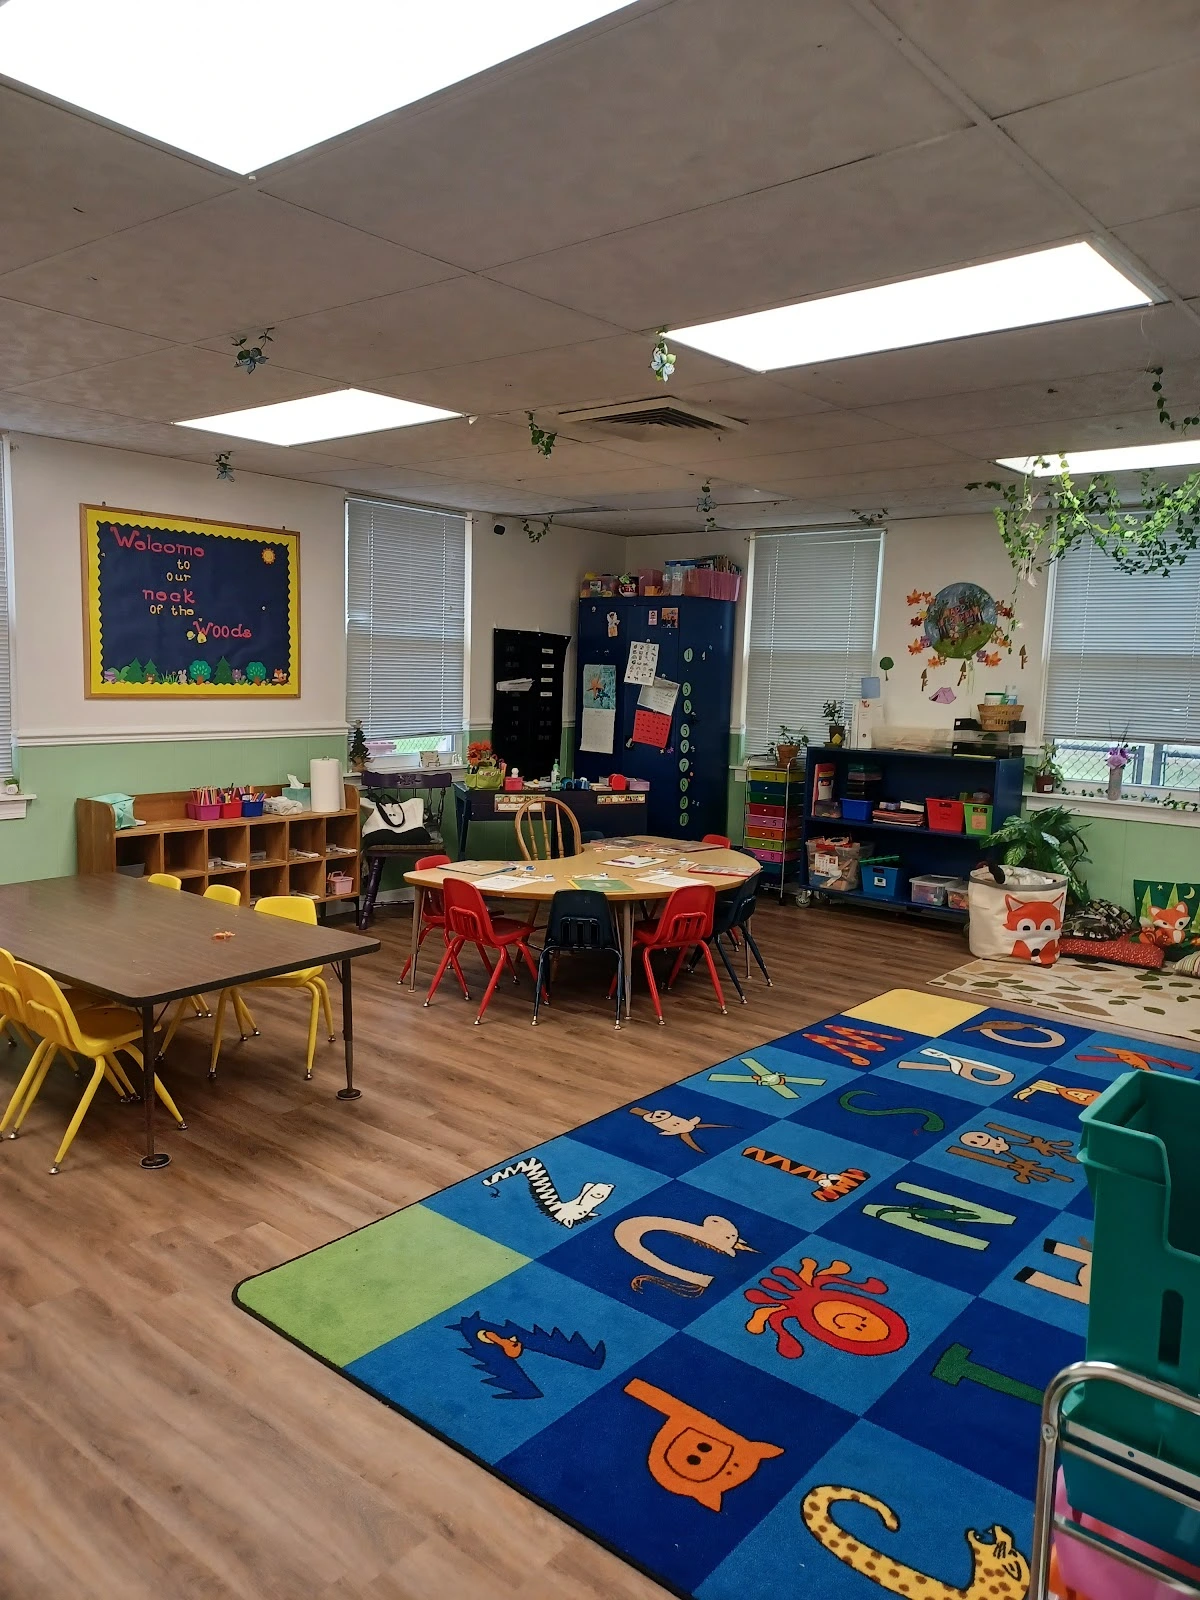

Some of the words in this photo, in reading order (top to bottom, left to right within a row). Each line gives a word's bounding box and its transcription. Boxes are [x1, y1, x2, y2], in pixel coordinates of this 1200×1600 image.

[109, 526, 205, 557] Welcome
[142, 588, 195, 604] neck
[171, 605, 195, 616] the
